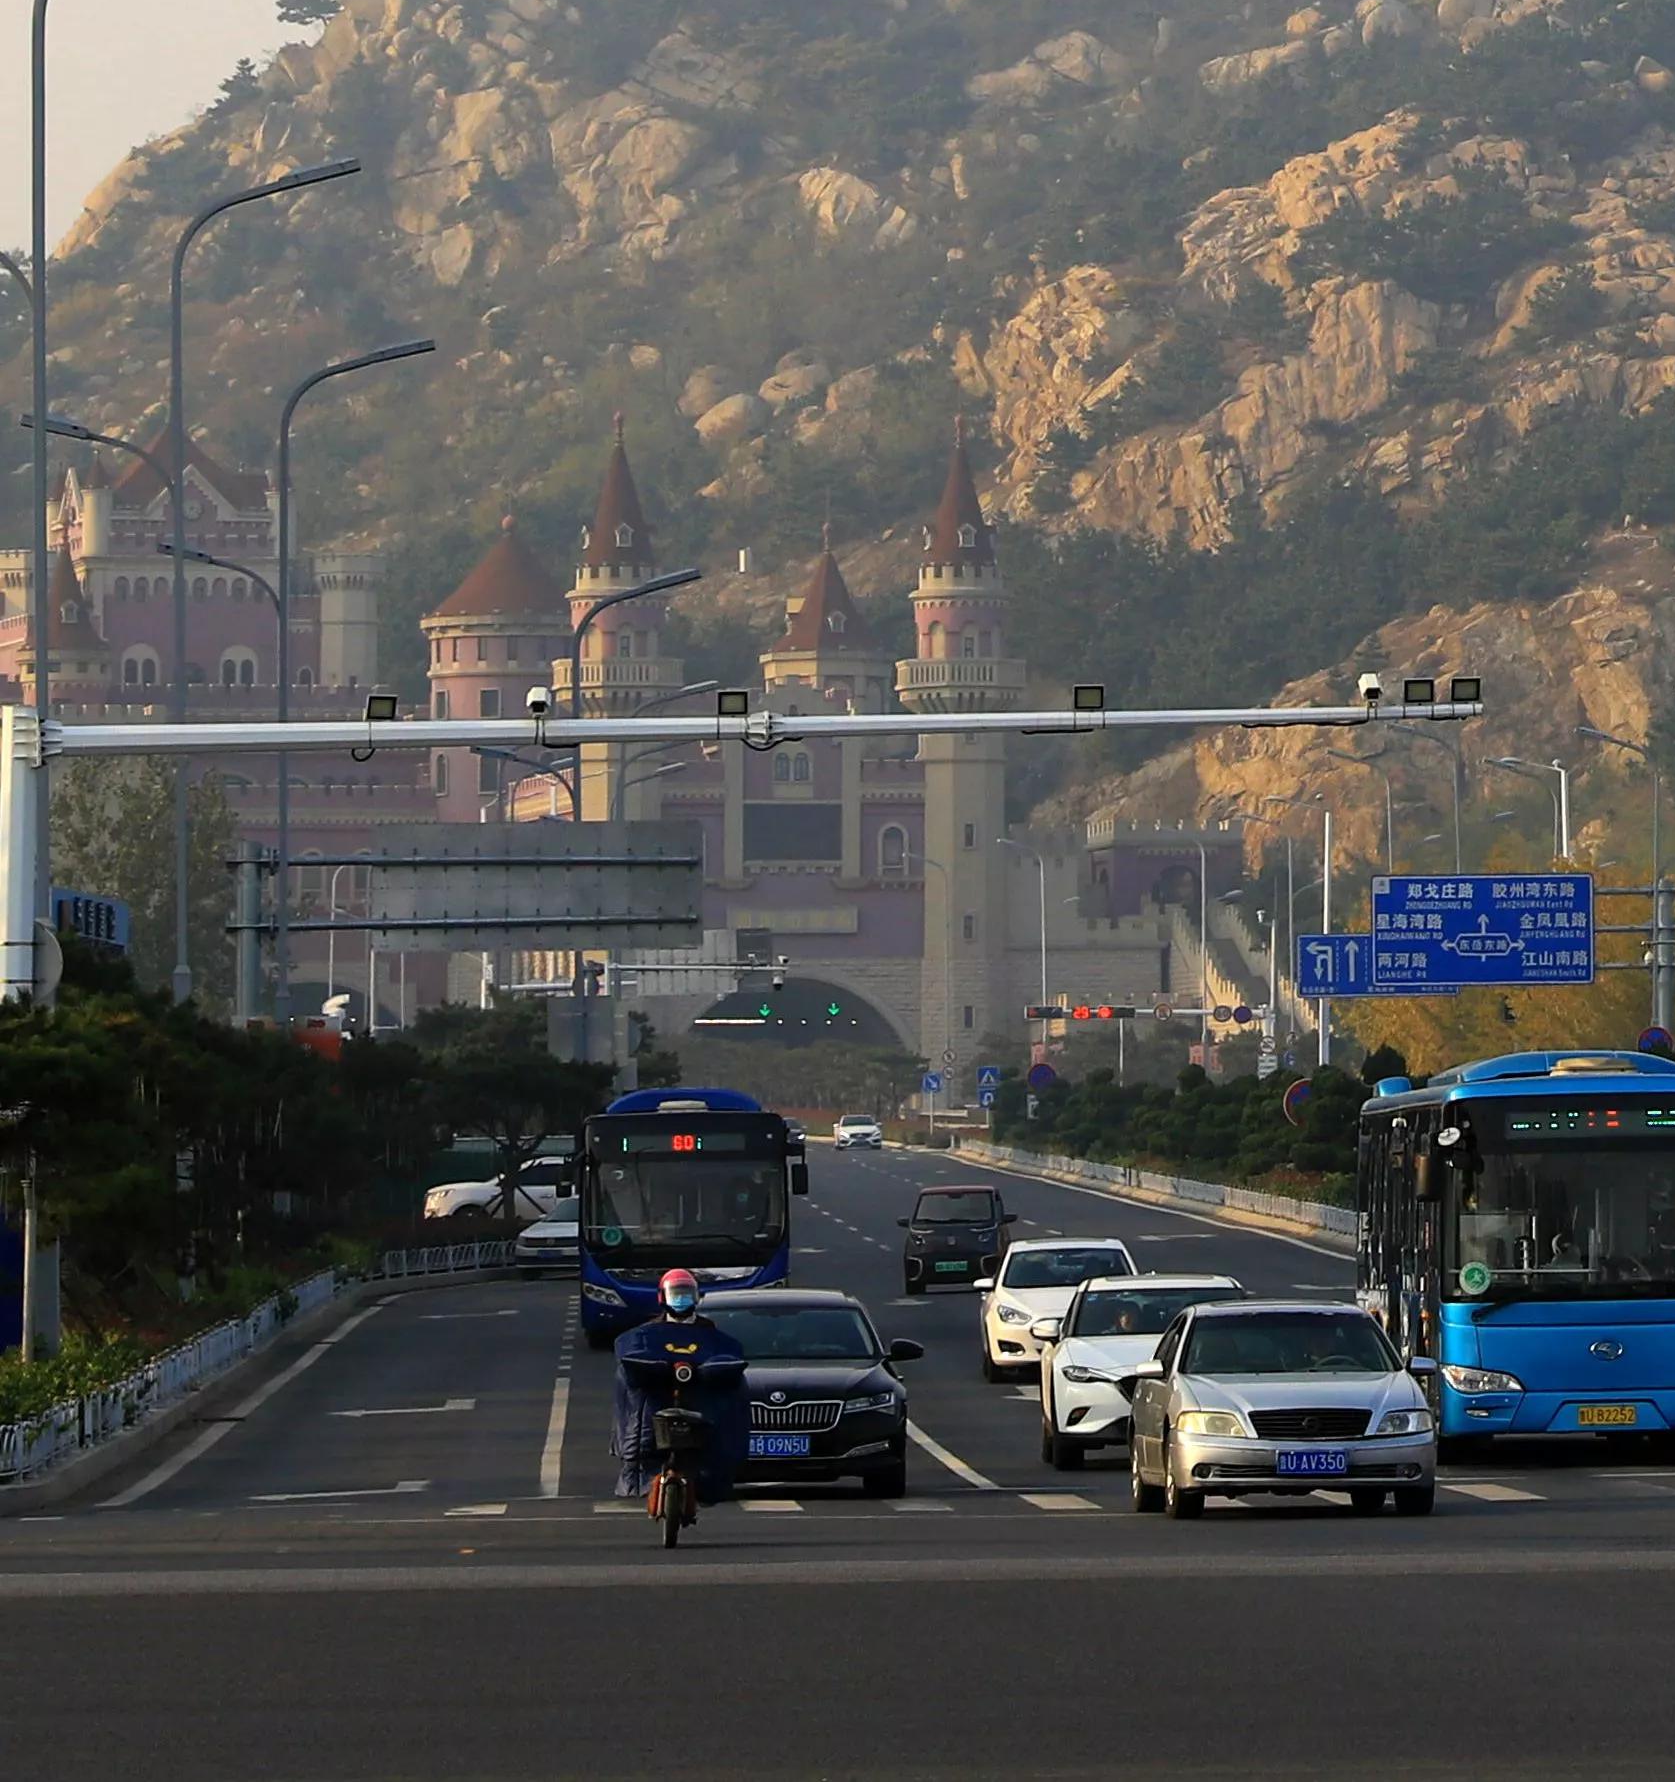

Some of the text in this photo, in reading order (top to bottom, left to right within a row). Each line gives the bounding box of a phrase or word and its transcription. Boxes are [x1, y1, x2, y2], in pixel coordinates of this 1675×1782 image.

[1408, 882, 1473, 899] 郑戈庄路
[1378, 953, 1427, 968] 两河路
[1522, 950, 1588, 966] 江山南路
